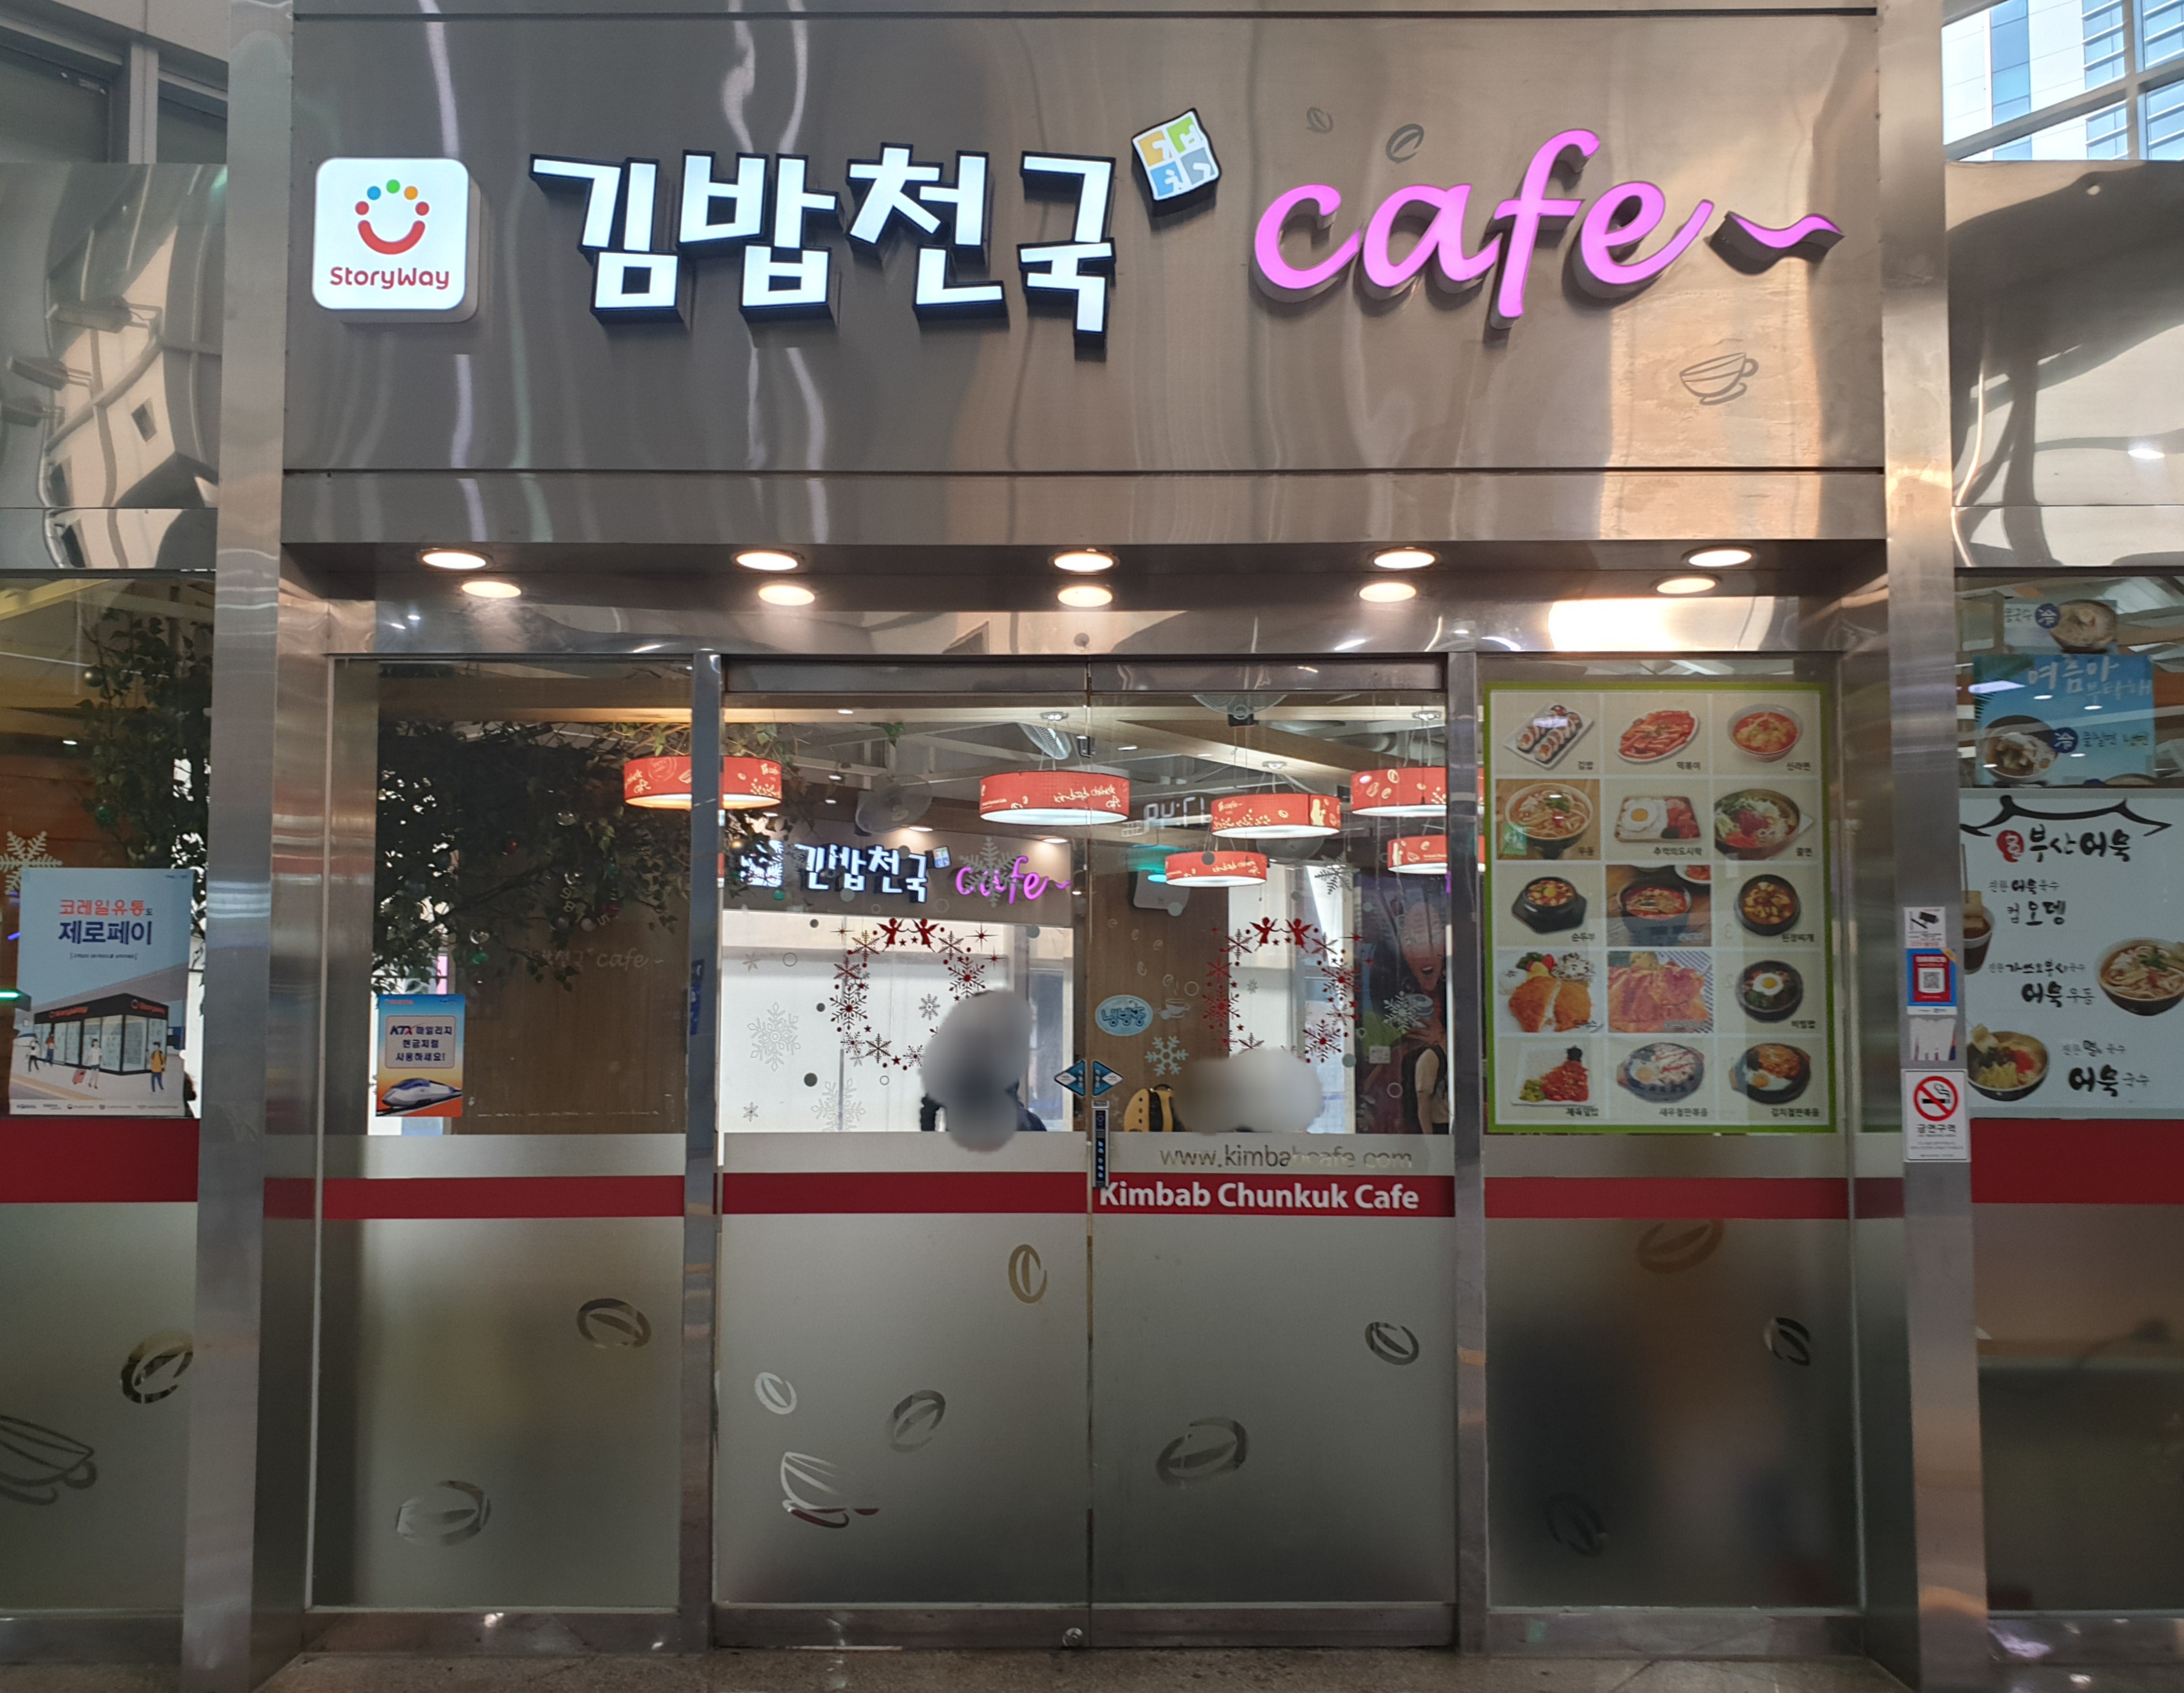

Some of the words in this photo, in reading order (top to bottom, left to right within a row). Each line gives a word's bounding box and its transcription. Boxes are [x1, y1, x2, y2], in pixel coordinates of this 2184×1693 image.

[530, 143, 1116, 335] 김밥천국
[329, 267, 449, 290] StoryWay
[2028, 824, 2131, 863] 부산어묵
[2025, 900, 2067, 926] 오뎅
[58, 920, 153, 945] 제로페이
[1100, 1006, 1147, 1027] 냉방중
[389, 1025, 414, 1036] KTX
[415, 1026, 453, 1036] 마일리지
[402, 1039, 440, 1049] 현금처럼
[1916, 1123, 1957, 1134] 금연구역
[1100, 1180, 1211, 1207] Kimbab
[1218, 1181, 1349, 1208] Chunkuk
[1354, 1183, 1419, 1209] Cafe
